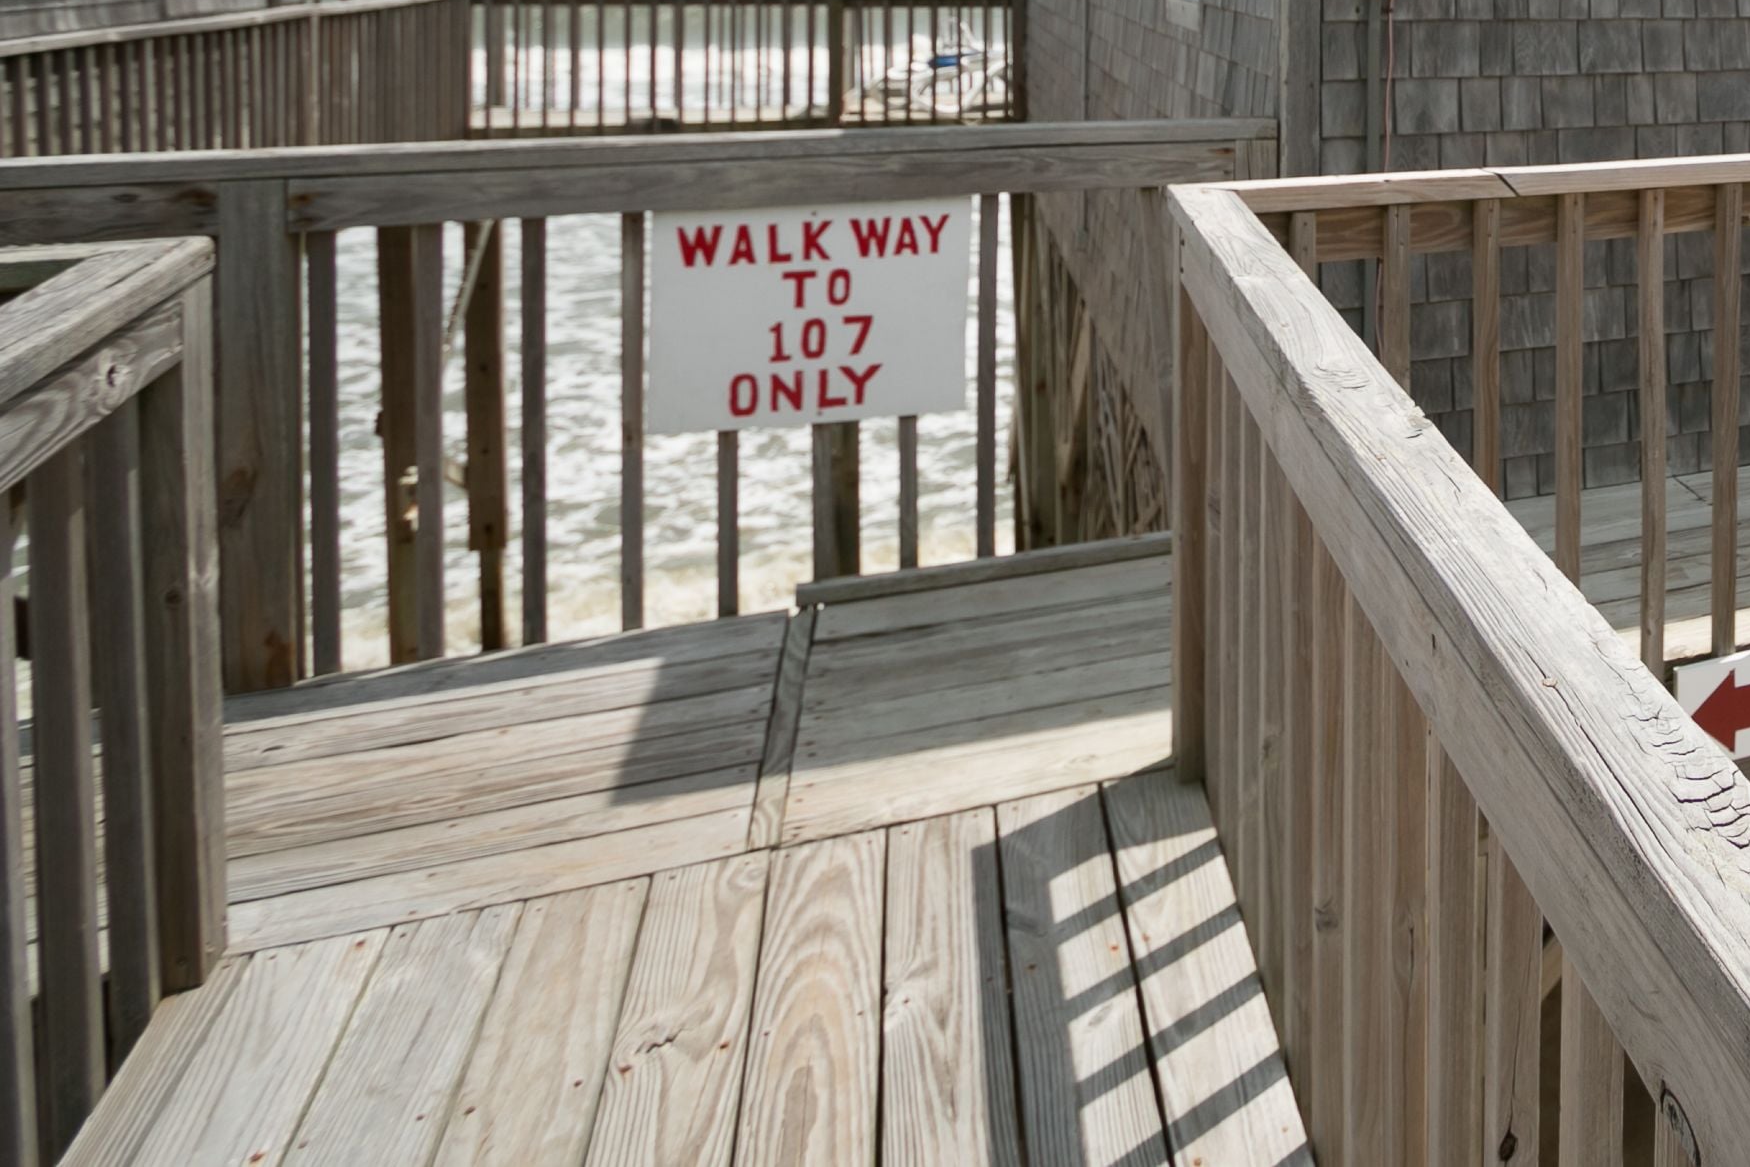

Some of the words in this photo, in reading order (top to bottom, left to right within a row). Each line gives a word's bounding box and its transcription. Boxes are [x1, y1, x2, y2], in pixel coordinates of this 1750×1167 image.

[781, 268, 851, 309] TO
[769, 315, 874, 363] 107
[728, 363, 883, 418] ONLY
